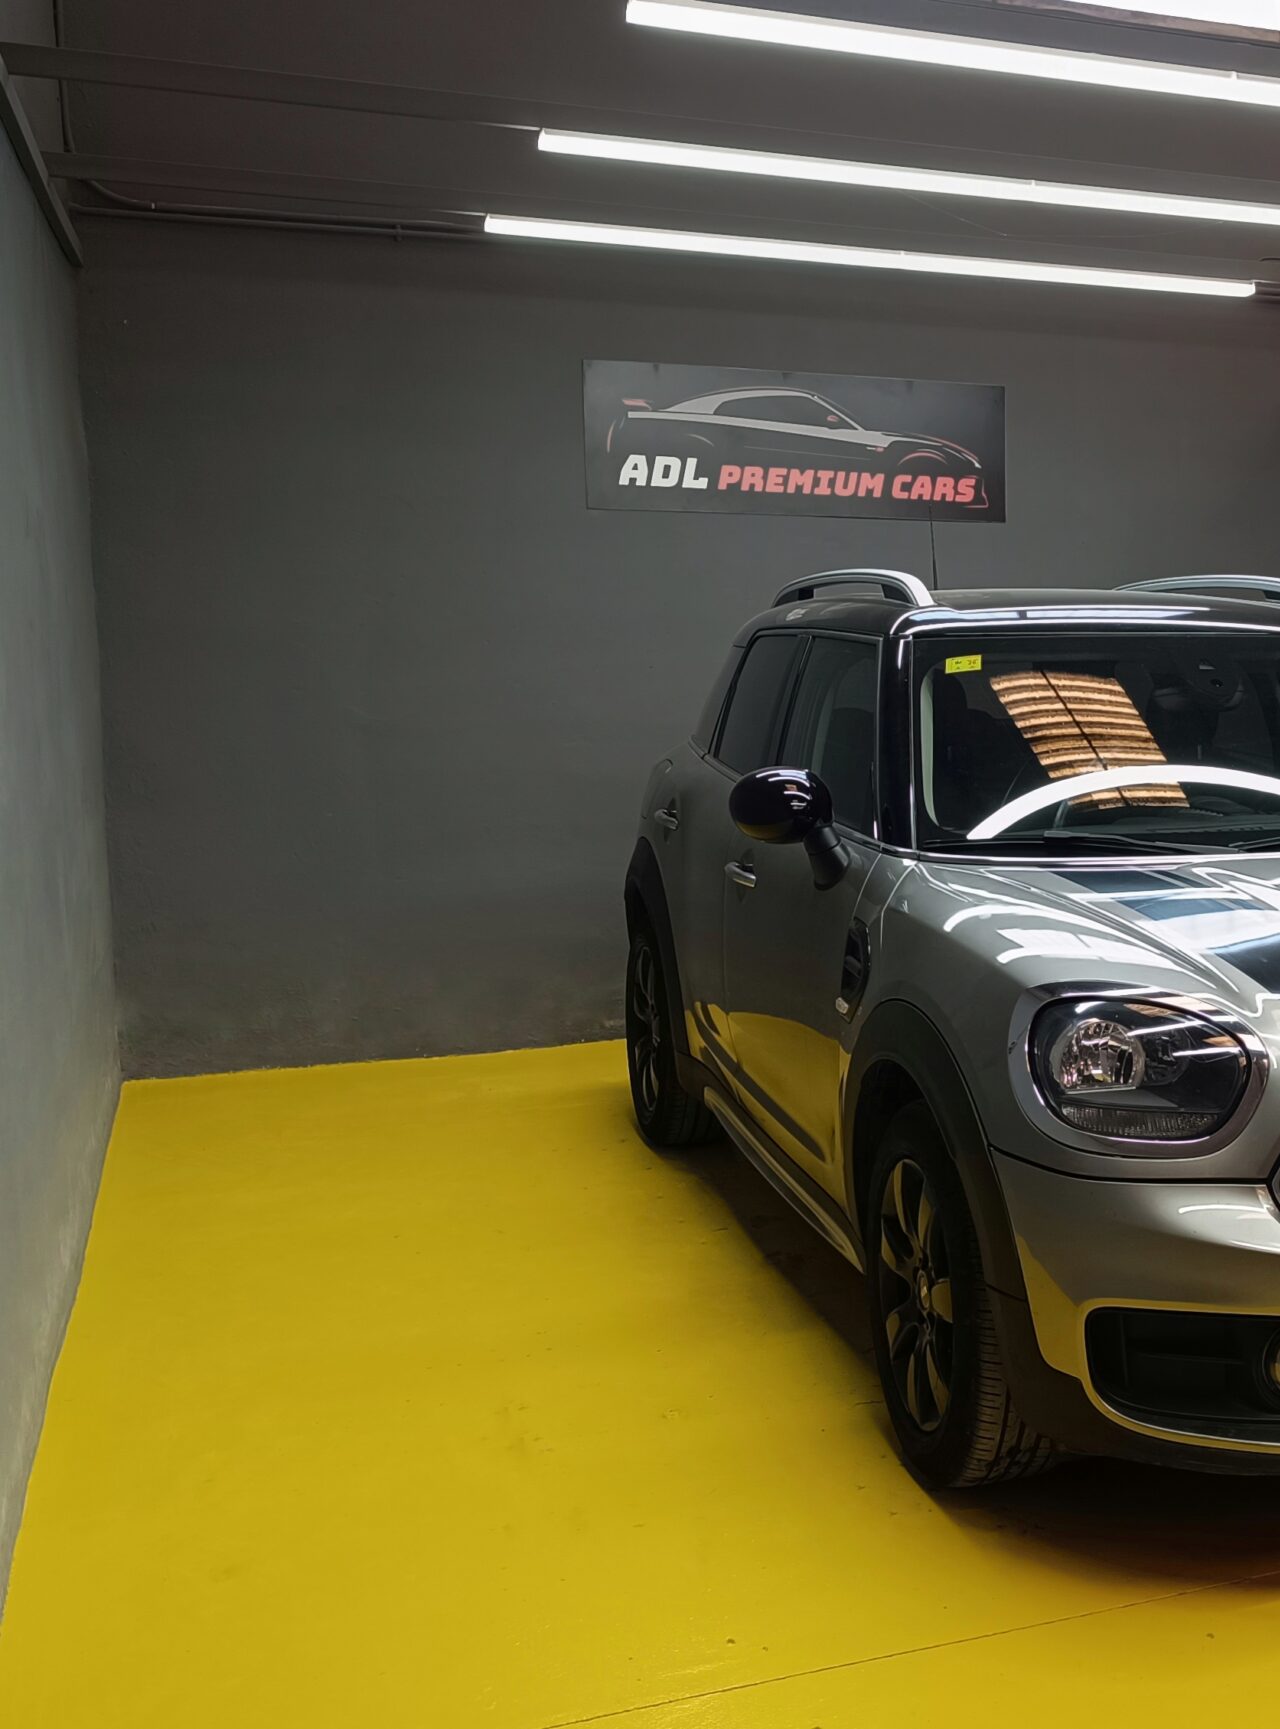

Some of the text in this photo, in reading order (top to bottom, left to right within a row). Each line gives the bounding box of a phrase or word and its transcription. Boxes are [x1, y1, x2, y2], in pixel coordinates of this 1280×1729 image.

[618, 454, 977, 503] ADL PREMIUM CARS
